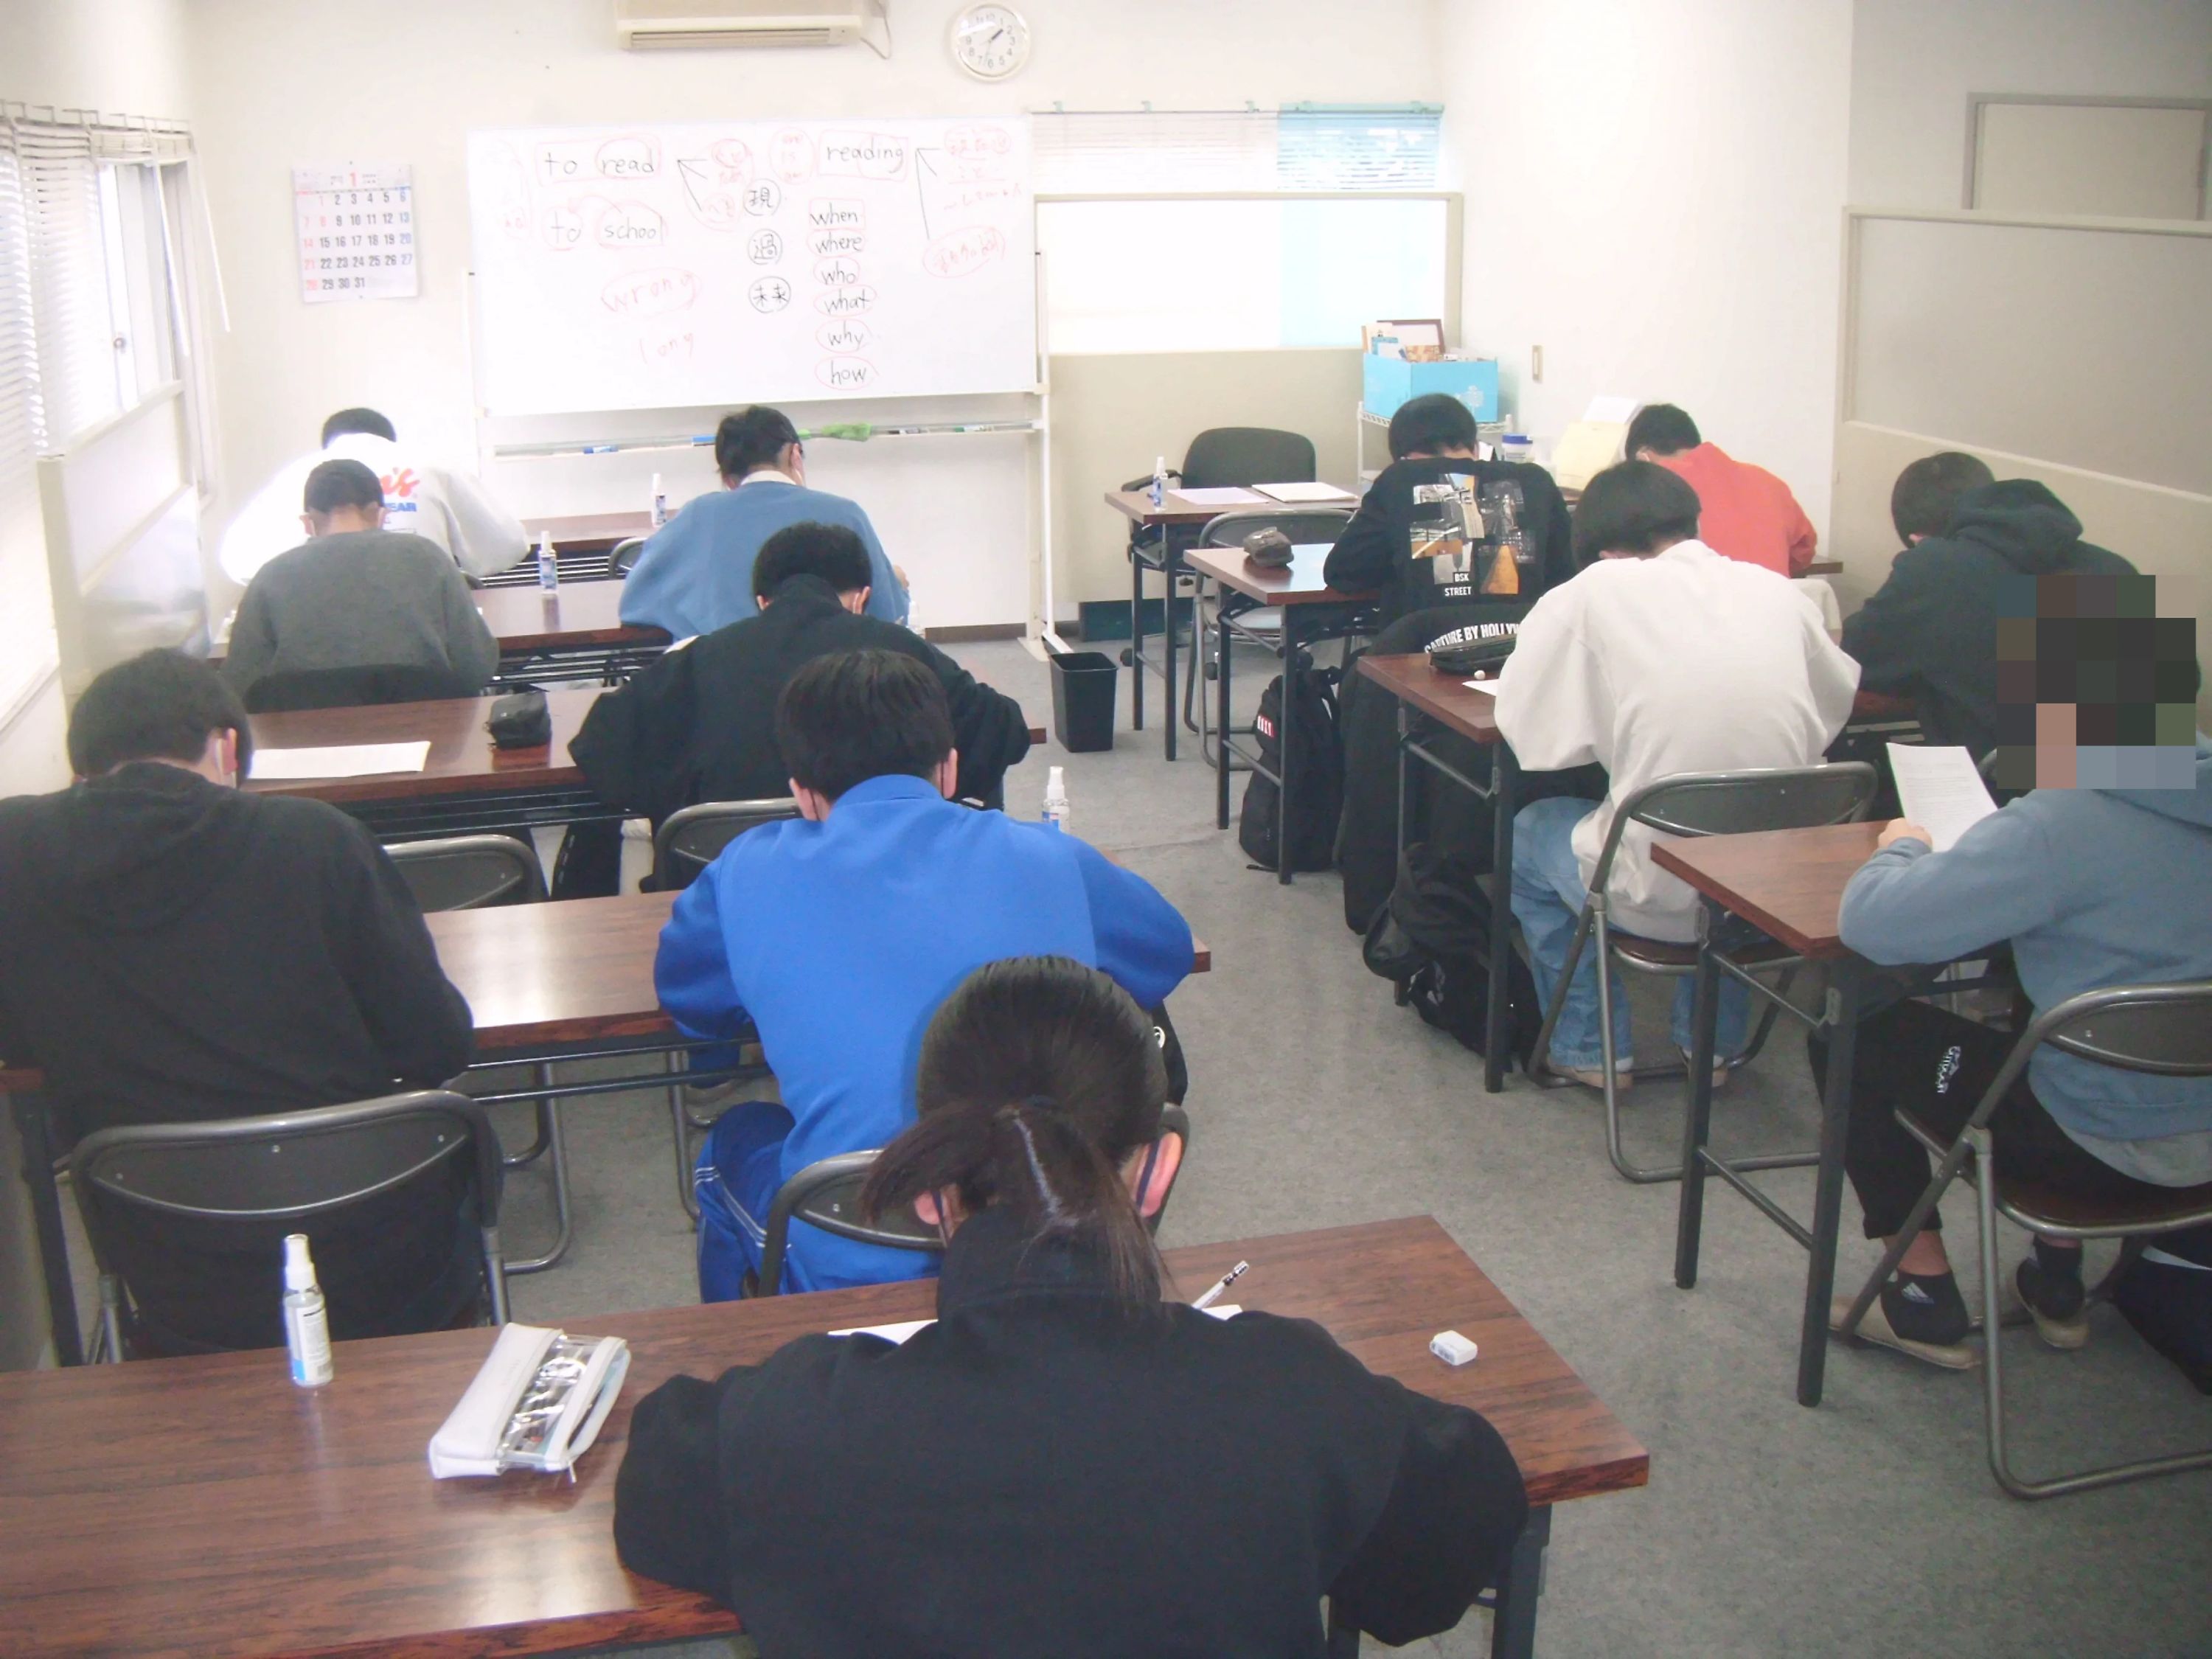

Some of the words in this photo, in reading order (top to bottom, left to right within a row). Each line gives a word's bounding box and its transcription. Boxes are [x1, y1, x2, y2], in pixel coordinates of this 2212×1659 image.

[545, 152, 578, 176] to
[600, 148, 654, 175] read
[827, 137, 905, 173] reading
[349, 171, 357, 187] 1
[335, 195, 341, 205] 2
[351, 194, 357, 204] 3
[367, 193, 373, 203] 4
[383, 193, 389, 203] 5
[400, 192, 406, 202] 6
[749, 186, 773, 209] 現
[336, 215, 342, 226] 9
[350, 215, 361, 226] 10
[367, 214, 376, 224] 11
[383, 213, 393, 224] 12
[400, 212, 409, 223] 13
[810, 202, 858, 225] when
[550, 211, 581, 244] to
[604, 215, 663, 242] school
[304, 239, 313, 248] 14
[320, 237, 330, 248] 15
[335, 237, 346, 247] 16
[352, 235, 361, 246] 17
[368, 235, 378, 246] 18
[384, 234, 394, 245] 19
[400, 233, 411, 244] 20
[753, 233, 777, 260] 過
[815, 232, 863, 254] where
[305, 260, 315, 270] 21
[321, 258, 332, 269] 22
[336, 257, 348, 268] 23
[353, 257, 364, 267] 24
[369, 255, 380, 266] 25
[385, 254, 397, 265] 26
[401, 254, 412, 265] 27
[821, 261, 856, 285] who
[322, 279, 334, 290] 29
[338, 278, 349, 289] 30
[355, 277, 365, 288] 31
[601, 273, 696, 312] wrong
[824, 288, 871, 314] what
[828, 320, 864, 352] why
[639, 332, 695, 364] long
[830, 360, 866, 385] how
[1454, 573, 1470, 582] BSK
[1444, 586, 1472, 597] STREET
[1464, 625, 1478, 641] BY
